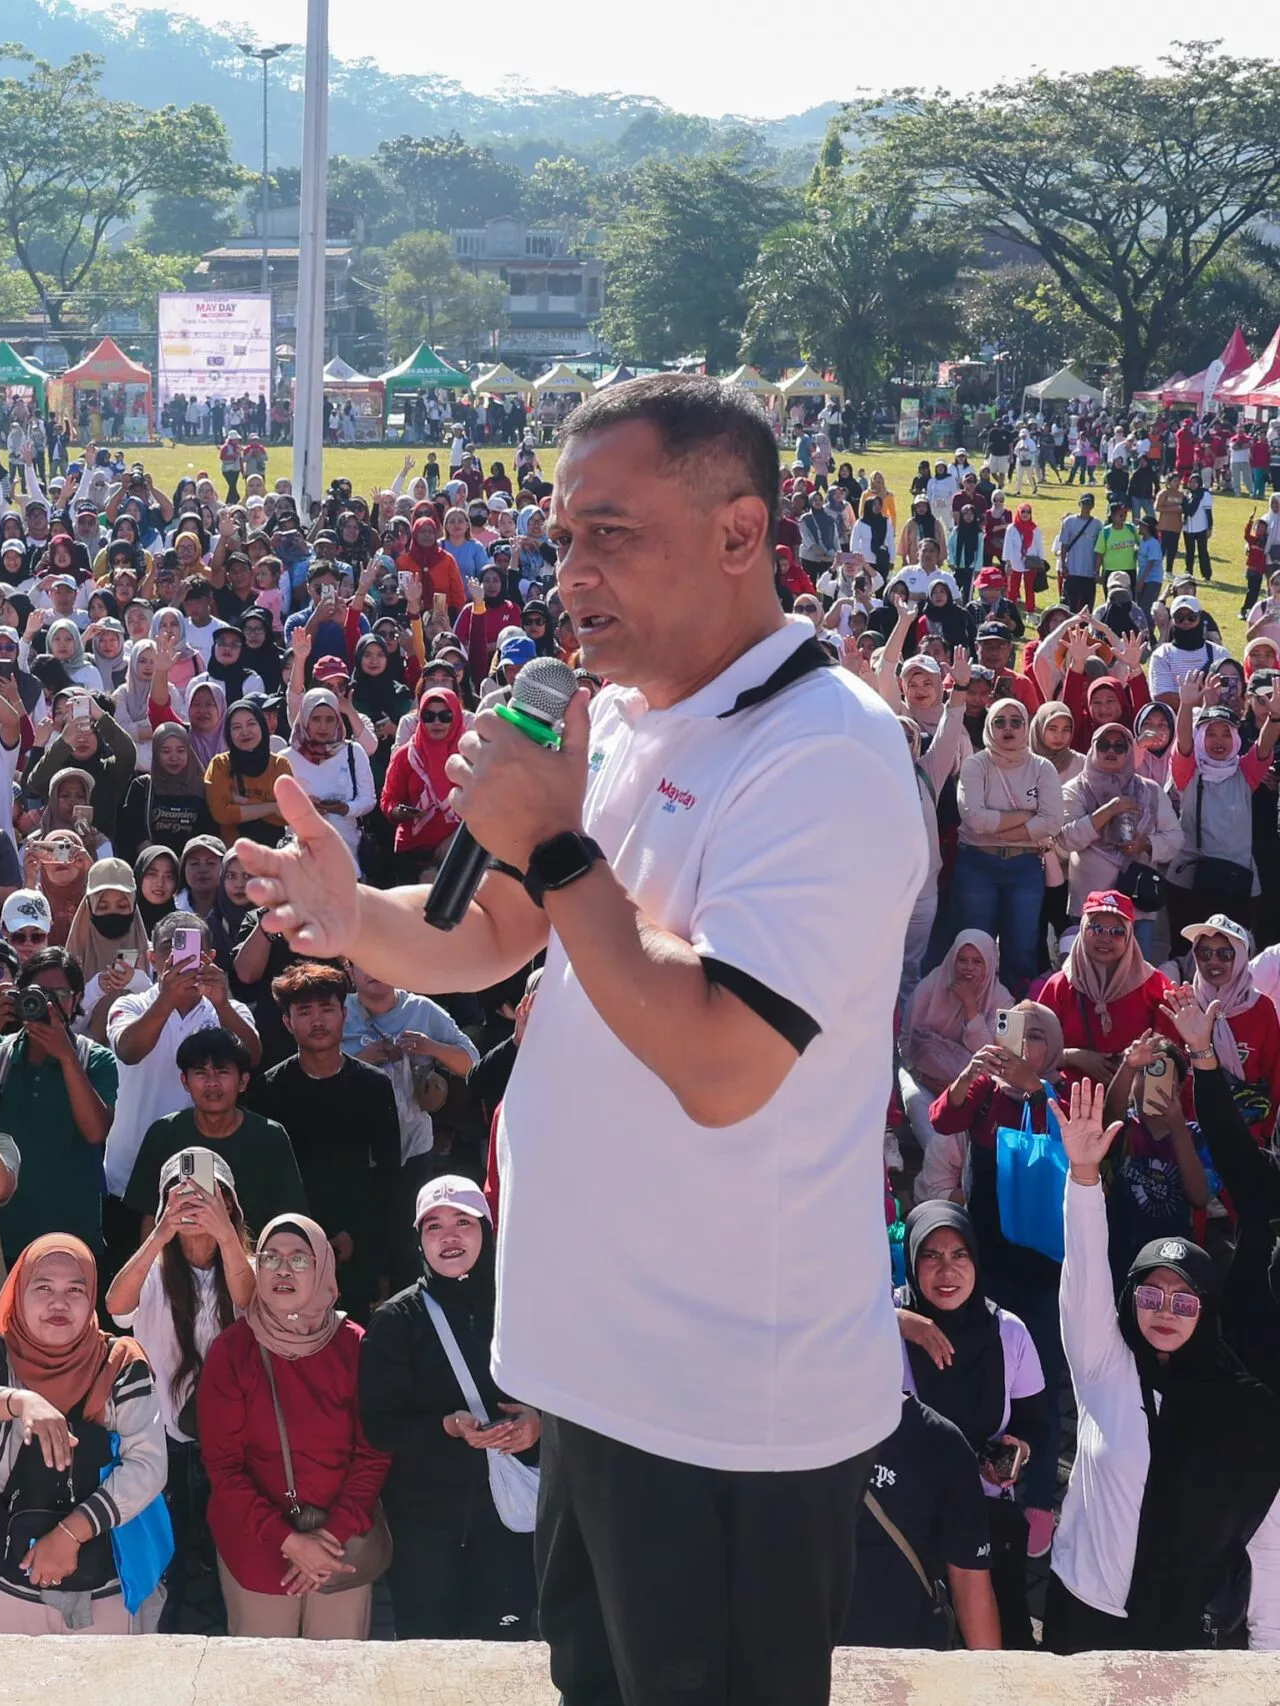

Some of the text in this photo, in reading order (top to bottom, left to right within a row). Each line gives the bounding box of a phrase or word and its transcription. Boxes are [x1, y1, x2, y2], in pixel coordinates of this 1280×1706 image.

[196, 303, 237, 312] MAY DAY
[657, 777, 696, 811] Mayday
